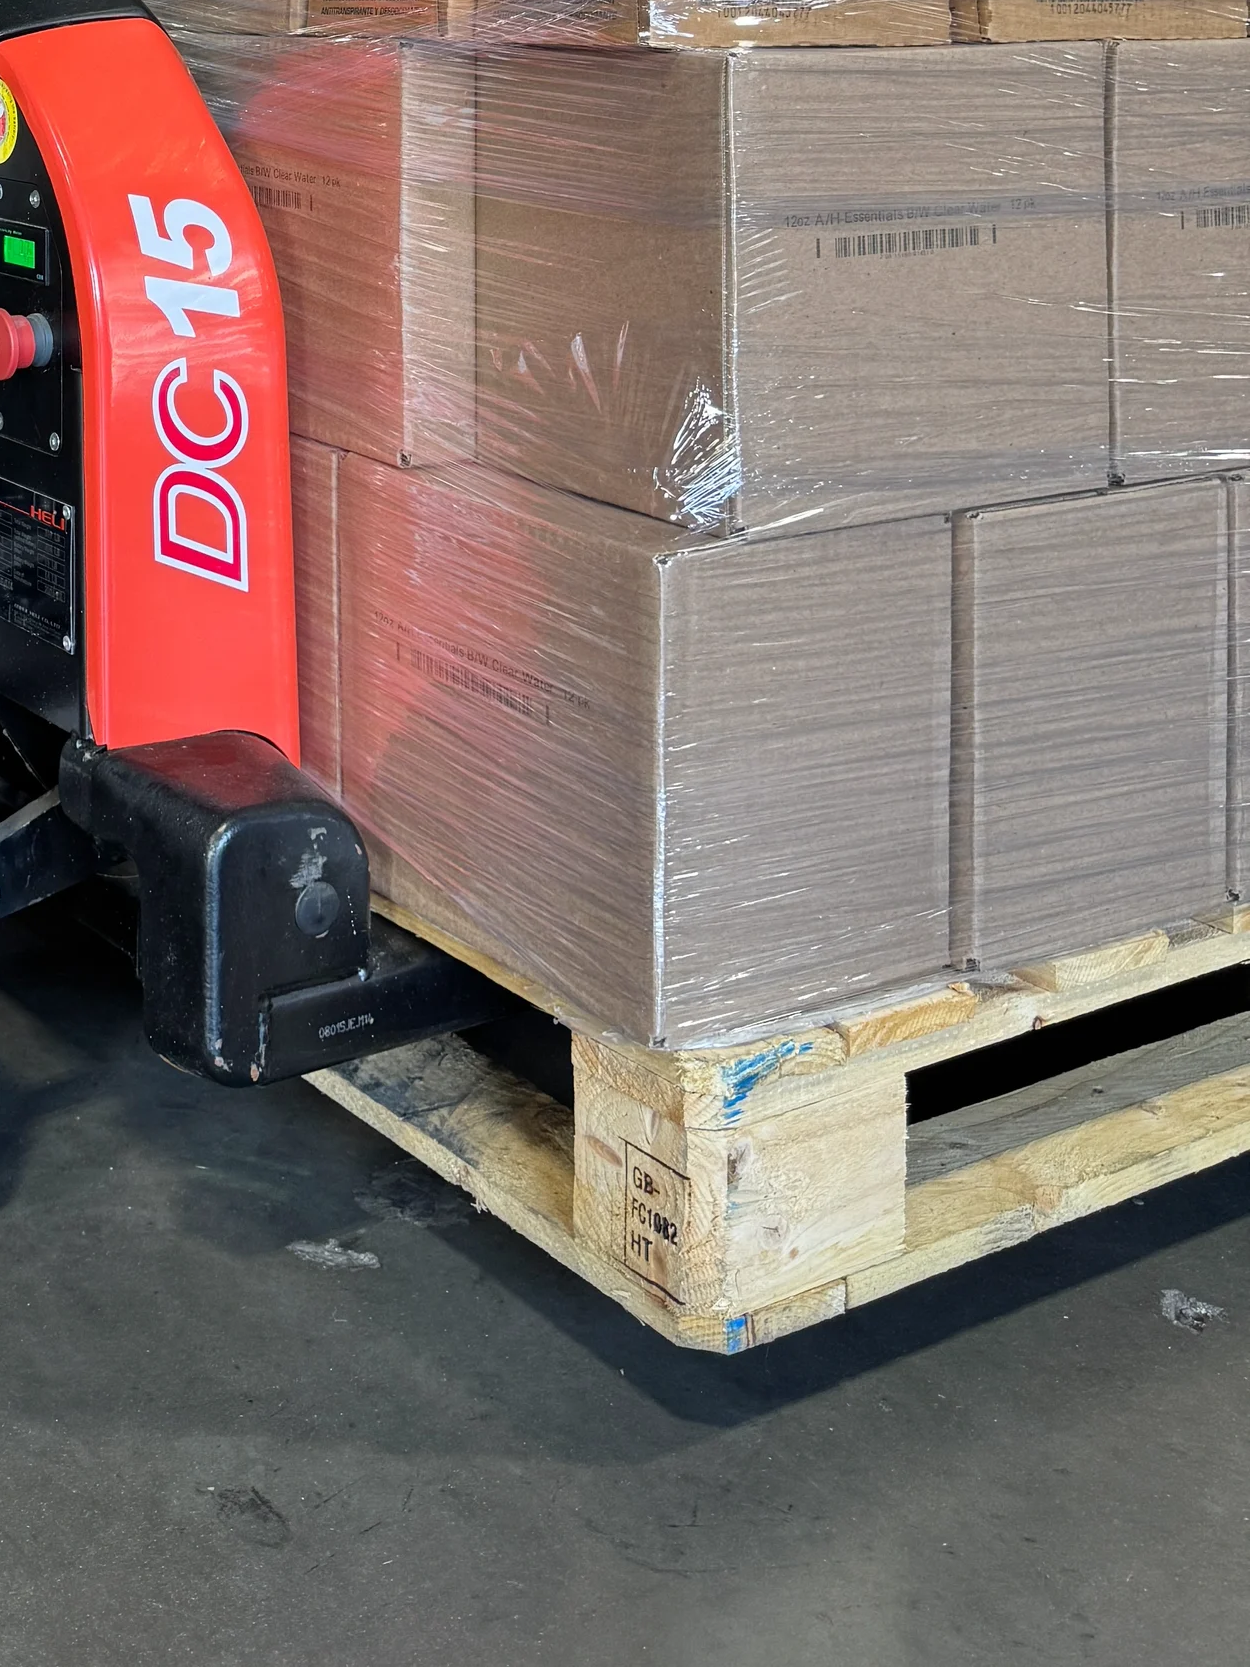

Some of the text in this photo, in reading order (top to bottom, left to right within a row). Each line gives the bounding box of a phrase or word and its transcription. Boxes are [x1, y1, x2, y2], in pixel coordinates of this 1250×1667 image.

[1051, 2, 1133, 16] 10012044045777
[255, 166, 272, 178] B/W
[273, 168, 292, 182] Clear
[293, 171, 316, 184] Water
[322, 176, 330, 186] 12
[784, 214, 811, 228] 12oz
[845, 209, 904, 224] Essentials
[127, 193, 250, 592] DC 15
[30, 505, 65, 532] HELI
[466, 649, 489, 667] B/W
[492, 659, 519, 678] Clear
[631, 1229, 654, 1262] HT
